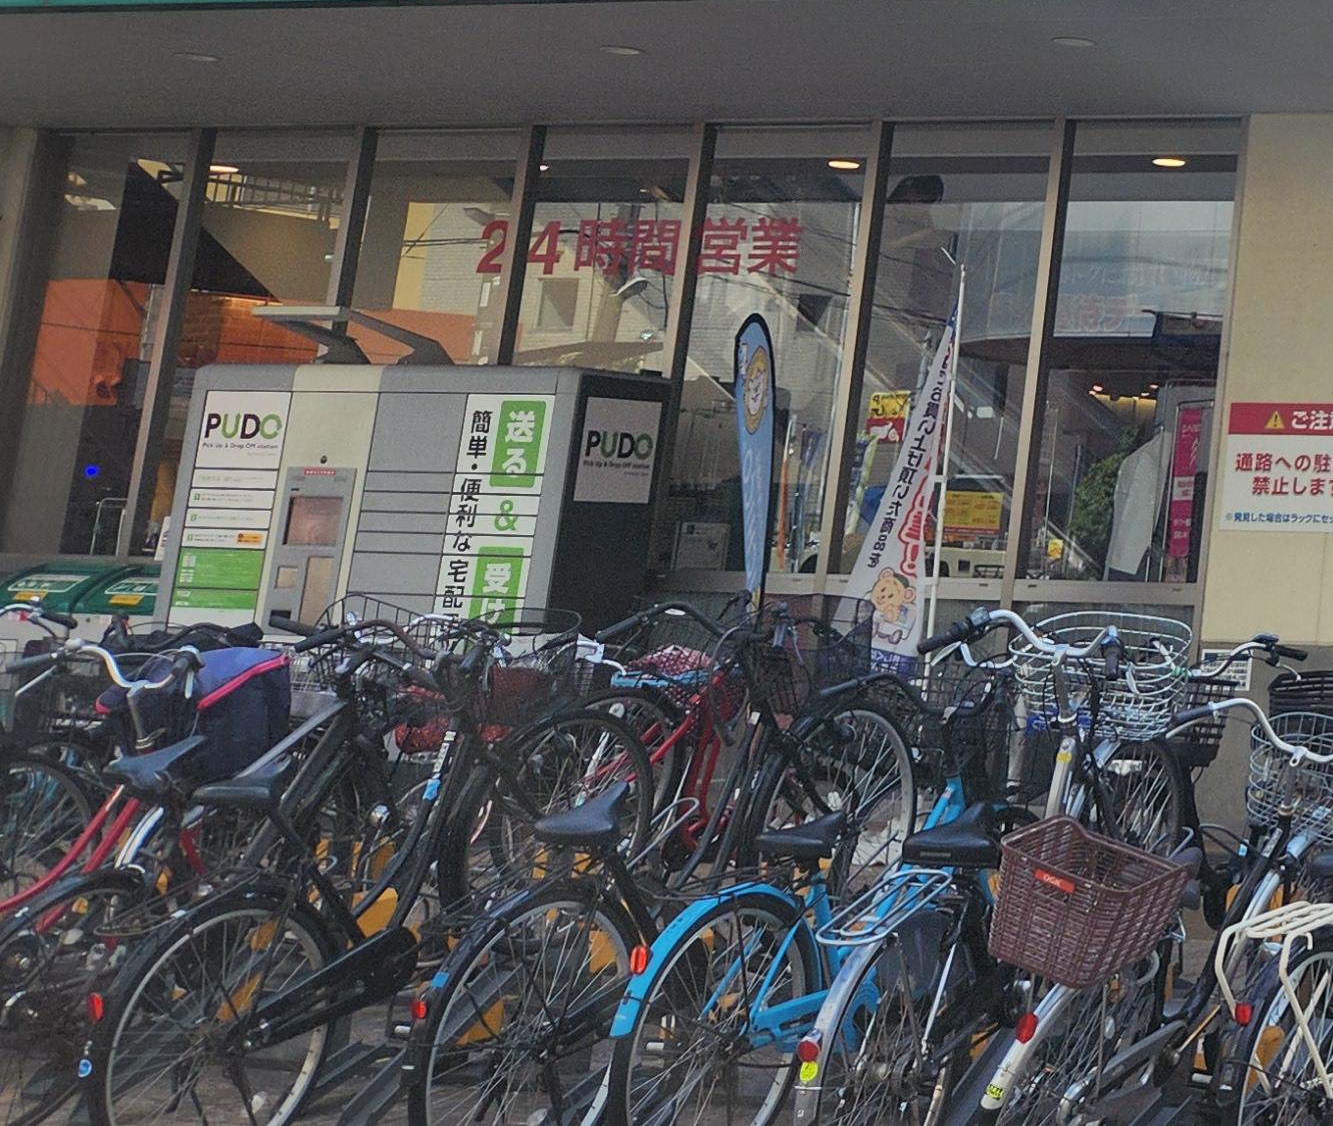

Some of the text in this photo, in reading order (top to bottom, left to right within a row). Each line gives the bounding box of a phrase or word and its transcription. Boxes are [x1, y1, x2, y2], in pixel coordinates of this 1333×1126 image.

[477, 217, 804, 276] 24時間営業
[204, 413, 282, 440] PUDO
[502, 410, 536, 478] 送る
[585, 430, 653, 461] PUDO
[494, 500, 518, 531] &
